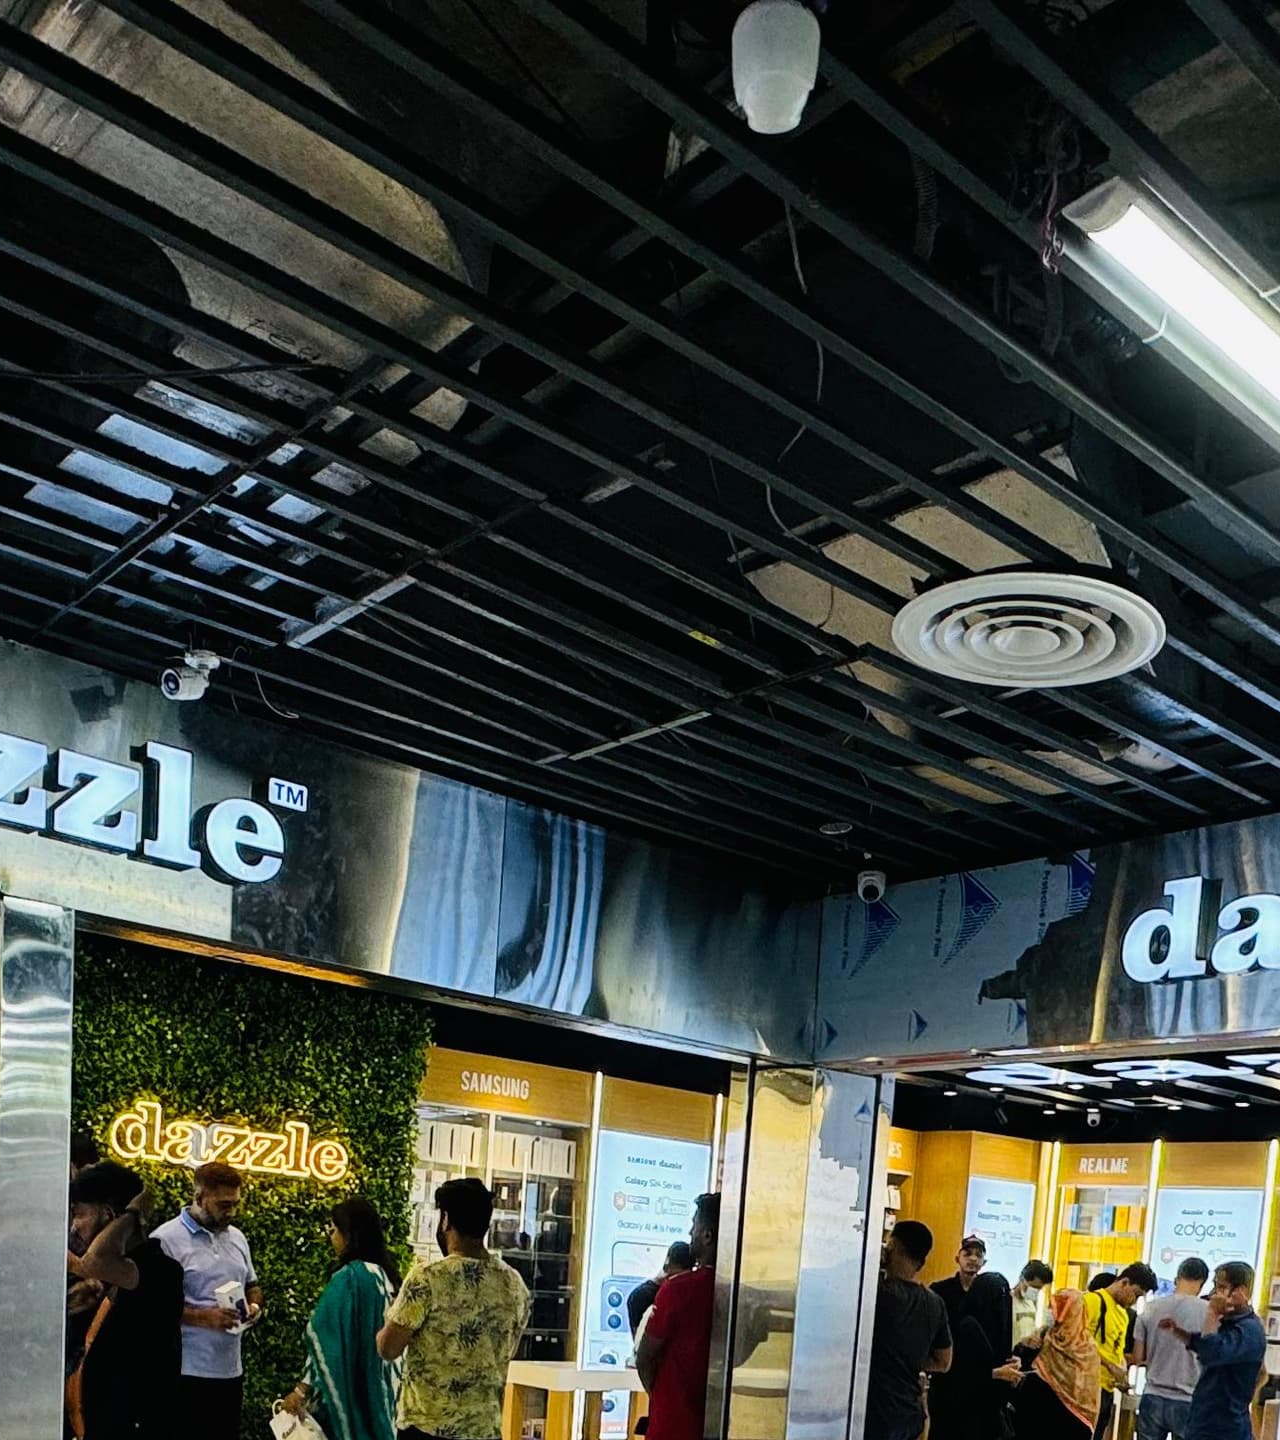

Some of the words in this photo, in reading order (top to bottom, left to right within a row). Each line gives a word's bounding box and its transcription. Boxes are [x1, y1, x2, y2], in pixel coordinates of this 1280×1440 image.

[460, 1070, 529, 1100] SAMSUNG
[110, 1100, 349, 1182] dazzle
[1078, 1157, 1129, 1175] REALME
[1174, 1221, 1216, 1243] edge
